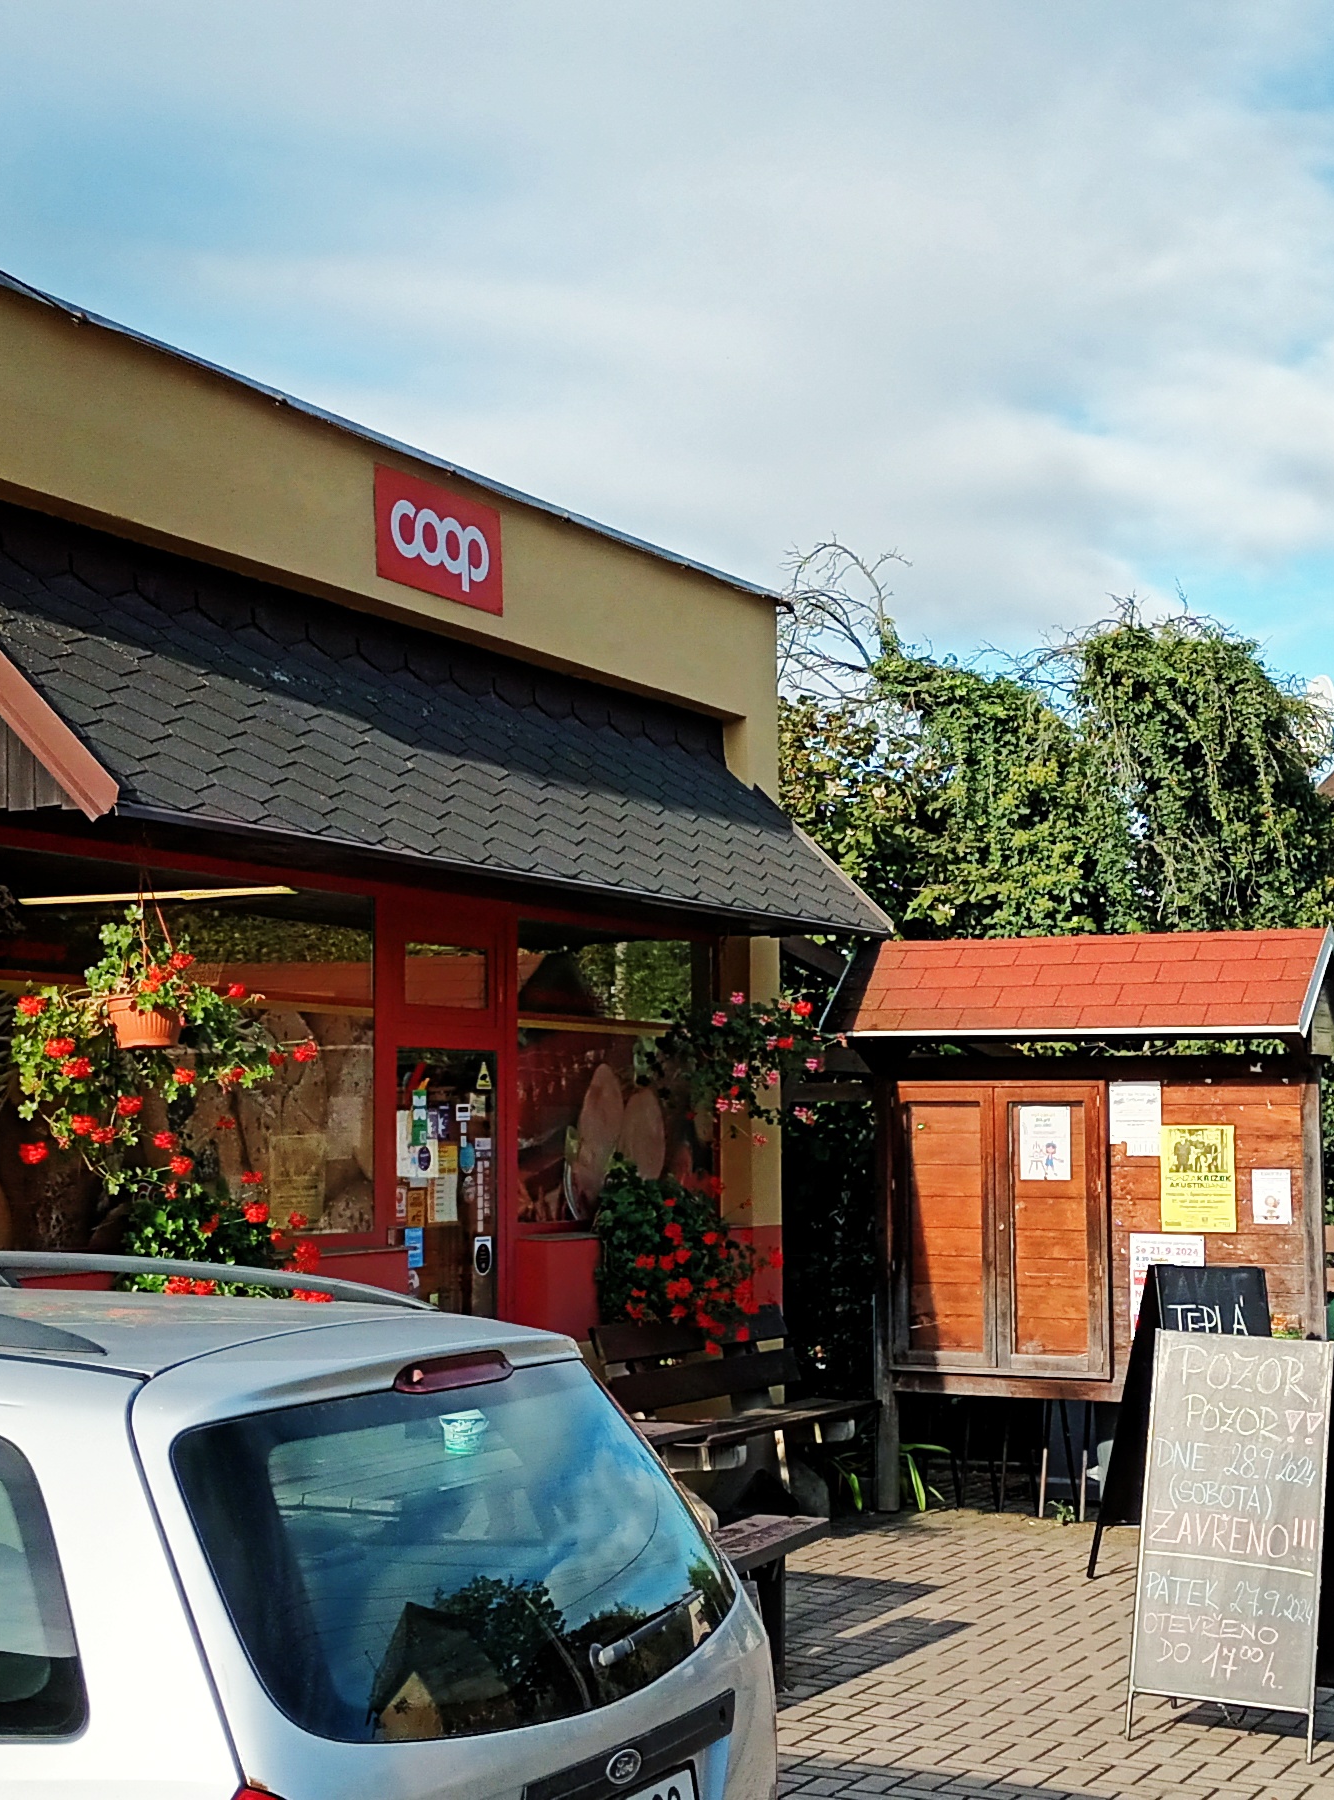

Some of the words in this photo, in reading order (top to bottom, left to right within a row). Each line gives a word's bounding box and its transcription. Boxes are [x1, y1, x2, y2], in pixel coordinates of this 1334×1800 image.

[391, 499, 489, 592] coop
[1155, 1437, 1210, 1472] DNE
[1169, 1474, 1273, 1521] (SOBOTA)
[1145, 1570, 1219, 1610] PÁTEK
[1143, 1612, 1278, 1645] OTEVŘENO
[1157, 1637, 1191, 1663] DO
